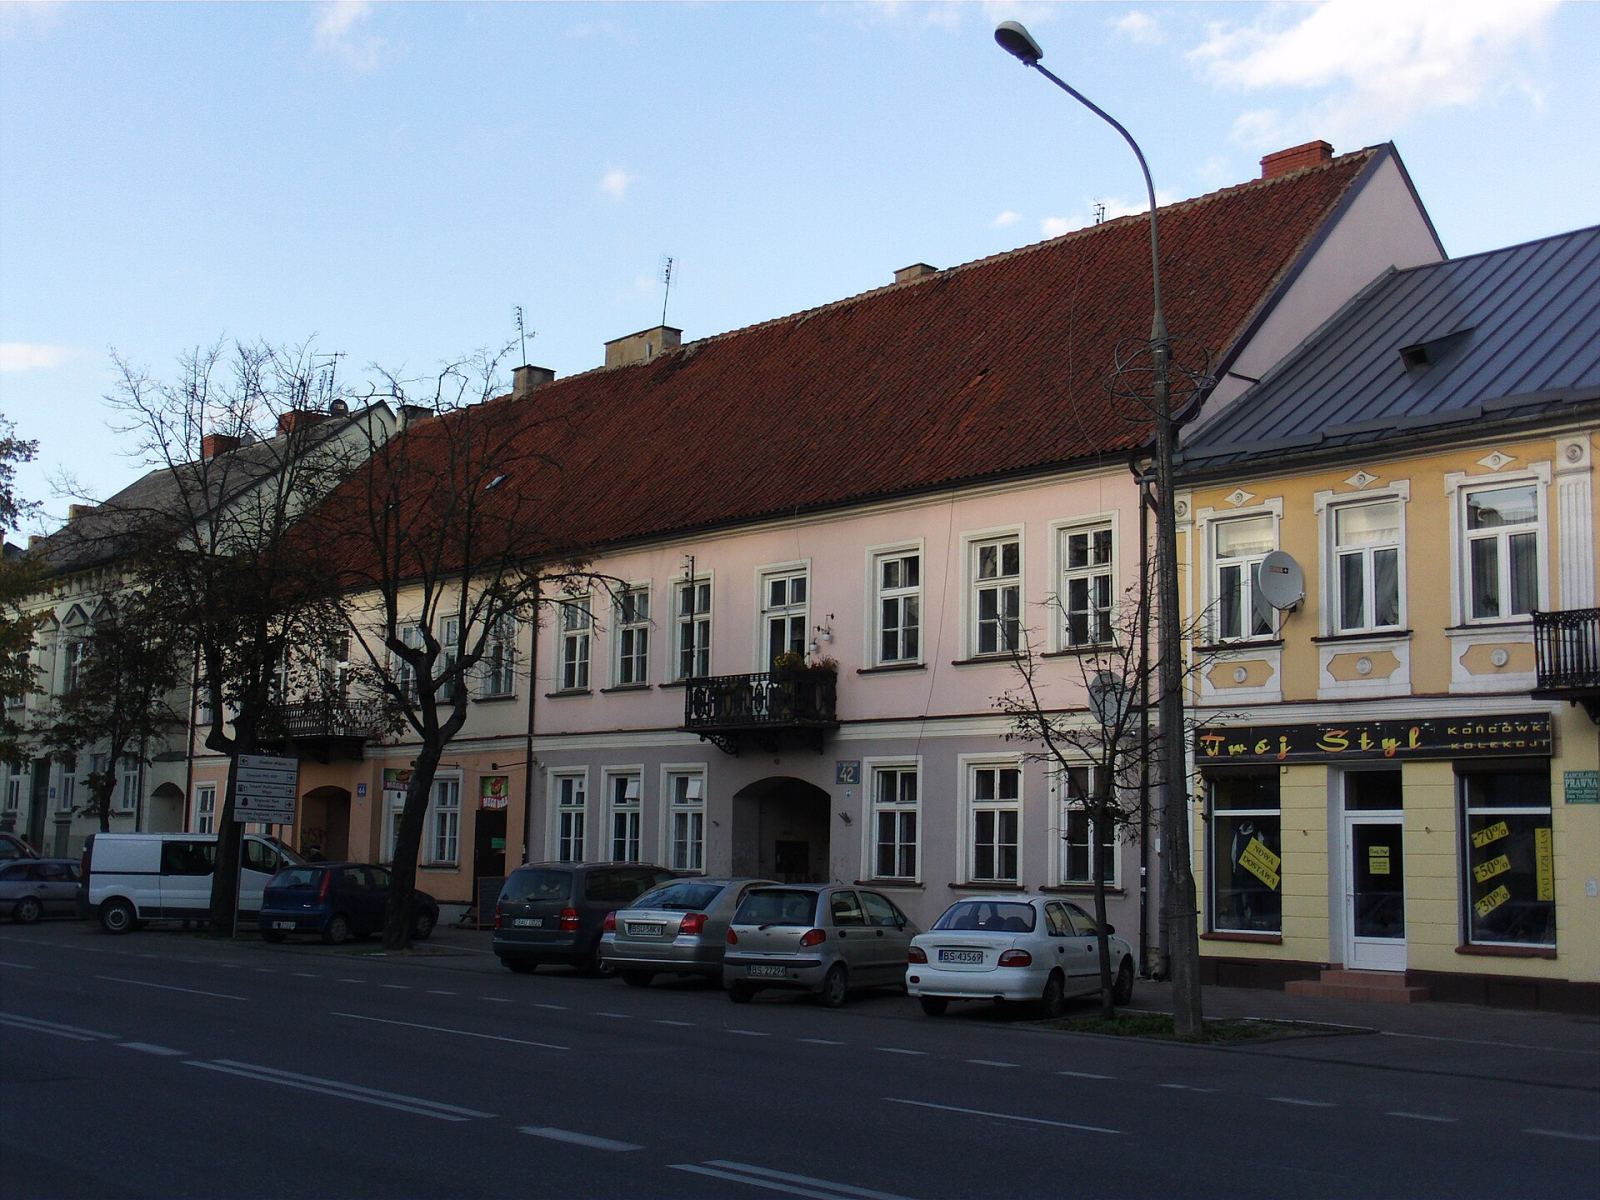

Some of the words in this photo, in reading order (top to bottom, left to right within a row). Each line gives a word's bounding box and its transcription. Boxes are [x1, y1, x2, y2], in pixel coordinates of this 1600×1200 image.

[1200, 733, 1291, 760] Twój
[1316, 727, 1421, 758] Styl
[840, 768, 854, 782] 42
[1565, 779, 1598, 788] PRAWNA
[1473, 824, 1507, 845] -70%
[1253, 845, 1274, 866] NOWA
[1242, 855, 1276, 885] DOSTAWA
[1475, 857, 1508, 878] -50%
[1478, 888, 1508, 912] -30%
[943, 952, 955, 961] BS
[957, 952, 982, 962] 43569
